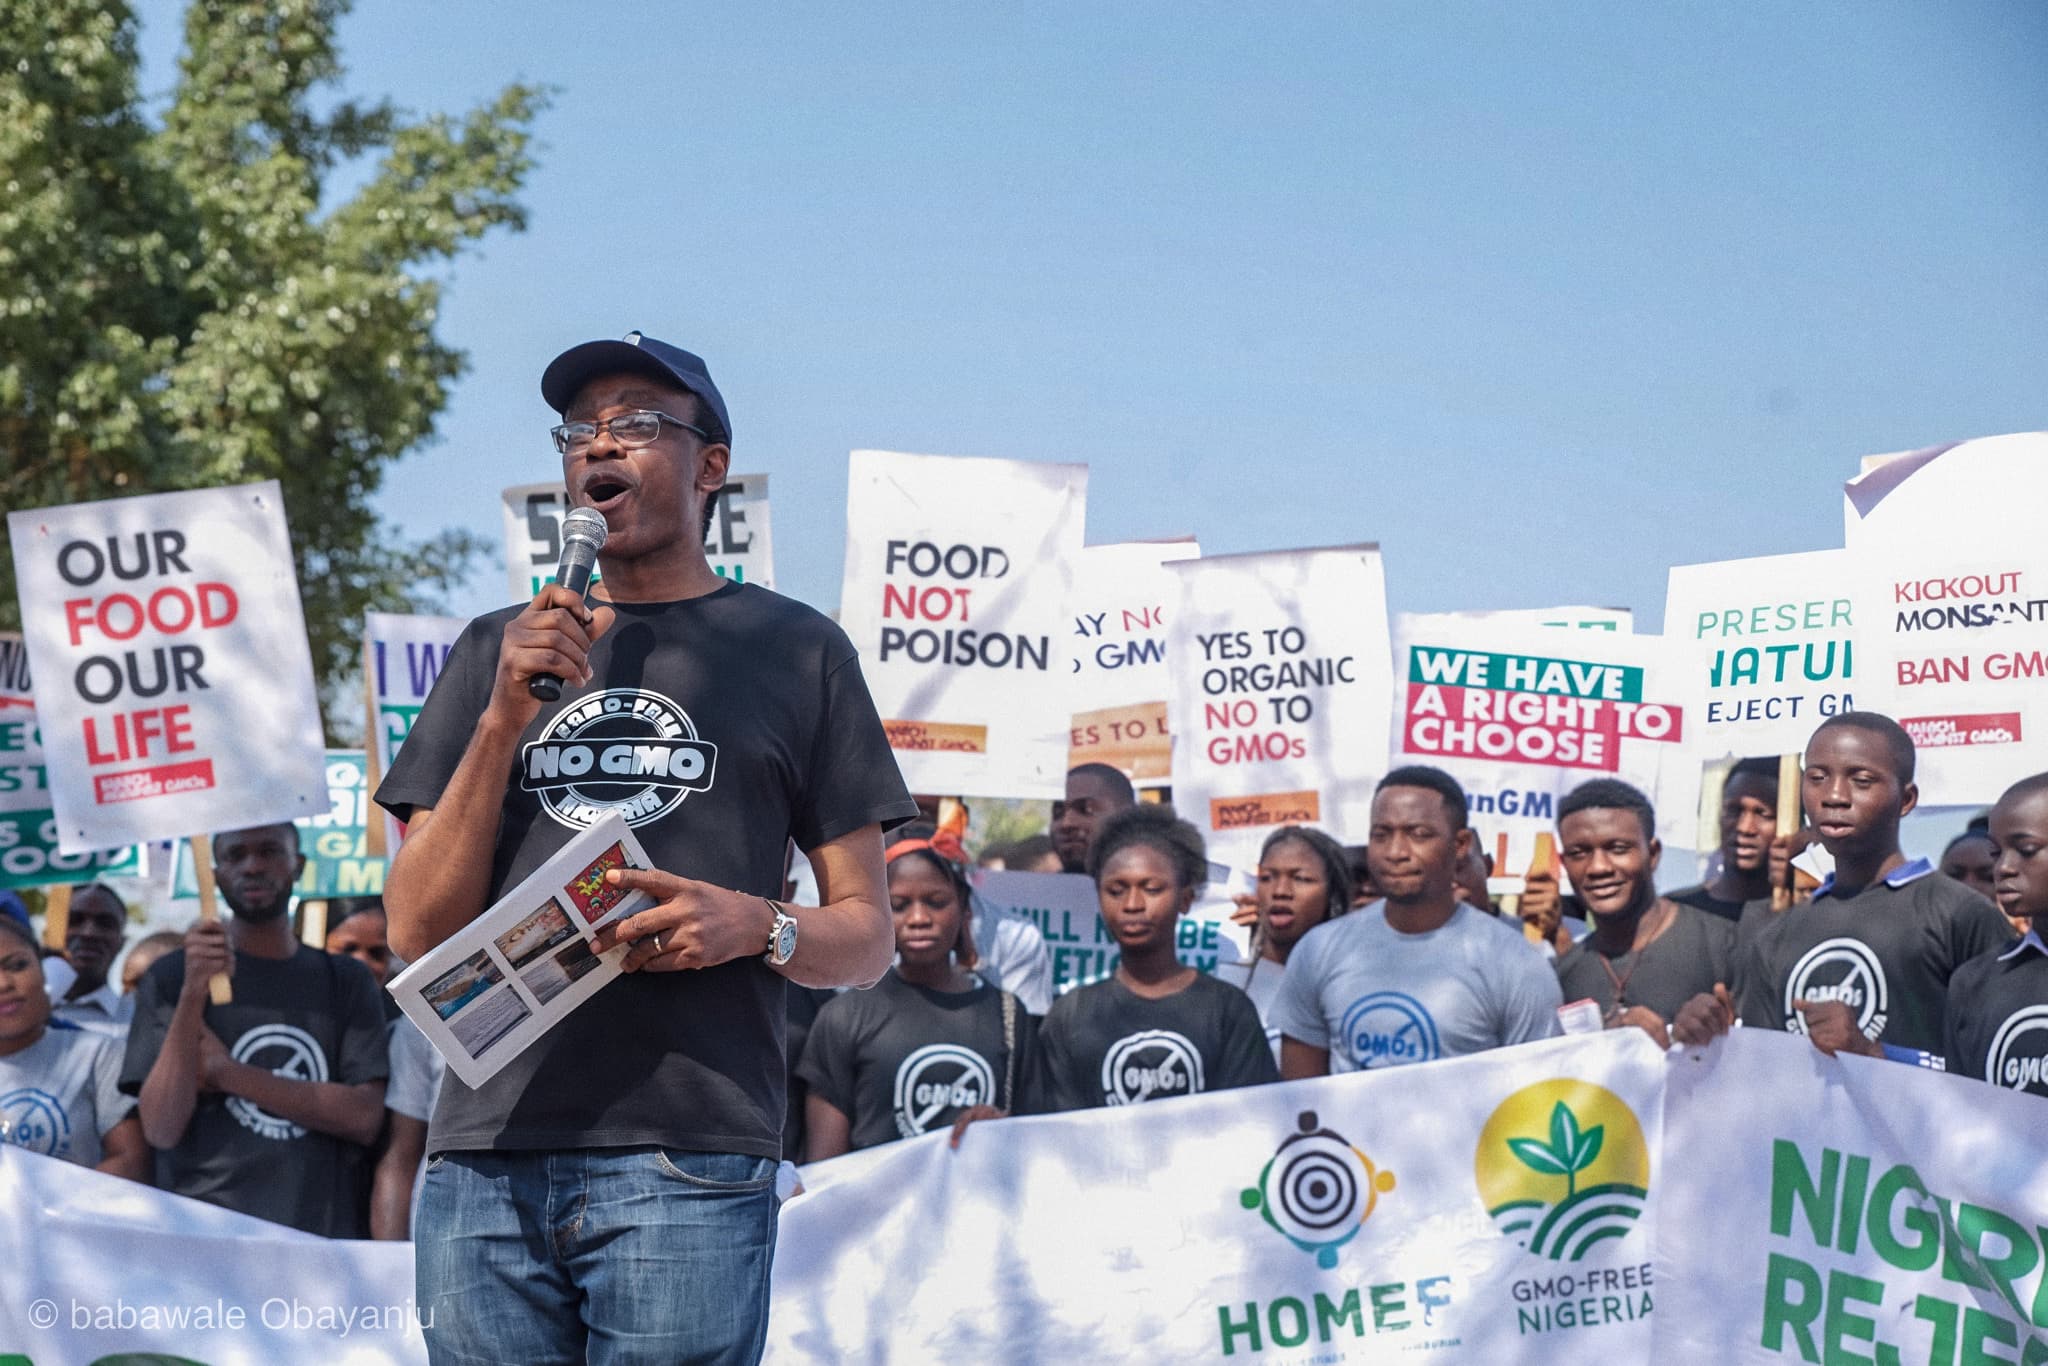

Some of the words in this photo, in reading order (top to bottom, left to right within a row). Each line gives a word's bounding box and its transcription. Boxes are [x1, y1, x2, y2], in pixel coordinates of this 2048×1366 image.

[58, 529, 193, 587] OUR
[885, 540, 1010, 579] FOOD
[883, 583, 972, 622] NOT
[1895, 572, 2022, 603] KICKOUT
[65, 581, 240, 646] FOOD
[1697, 599, 1854, 639] PRESER
[880, 627, 1049, 671] POISON
[1096, 638, 1165, 669] GM
[1197, 632, 1251, 661] YES
[1263, 627, 1306, 655] TO
[75, 643, 210, 704] OUR
[1203, 656, 1355, 695] ORGANIC
[1416, 650, 1490, 685] WE
[1504, 658, 1625, 700] HAVE
[1897, 656, 1970, 686] BAN
[1983, 651, 2048, 680] GM
[1205, 699, 1257, 730] NO
[1268, 695, 1313, 725] TO
[1412, 685, 1448, 718] A
[1463, 687, 1602, 730] RIGHT
[1613, 702, 1672, 739] TO
[1707, 696, 1805, 723] EJECT
[82, 704, 196, 766] LIFE
[1109, 720, 1146, 741] TO
[1208, 732, 1306, 765] GMOs
[1411, 717, 1605, 764] CHOOSE
[529, 745, 595, 780] NO
[599, 744, 706, 780] GMO
[1511, 1262, 1654, 1303] GMO-FREE
[1517, 1290, 1654, 1335] NIGERIA
[1760, 1252, 2048, 1366] REJE
